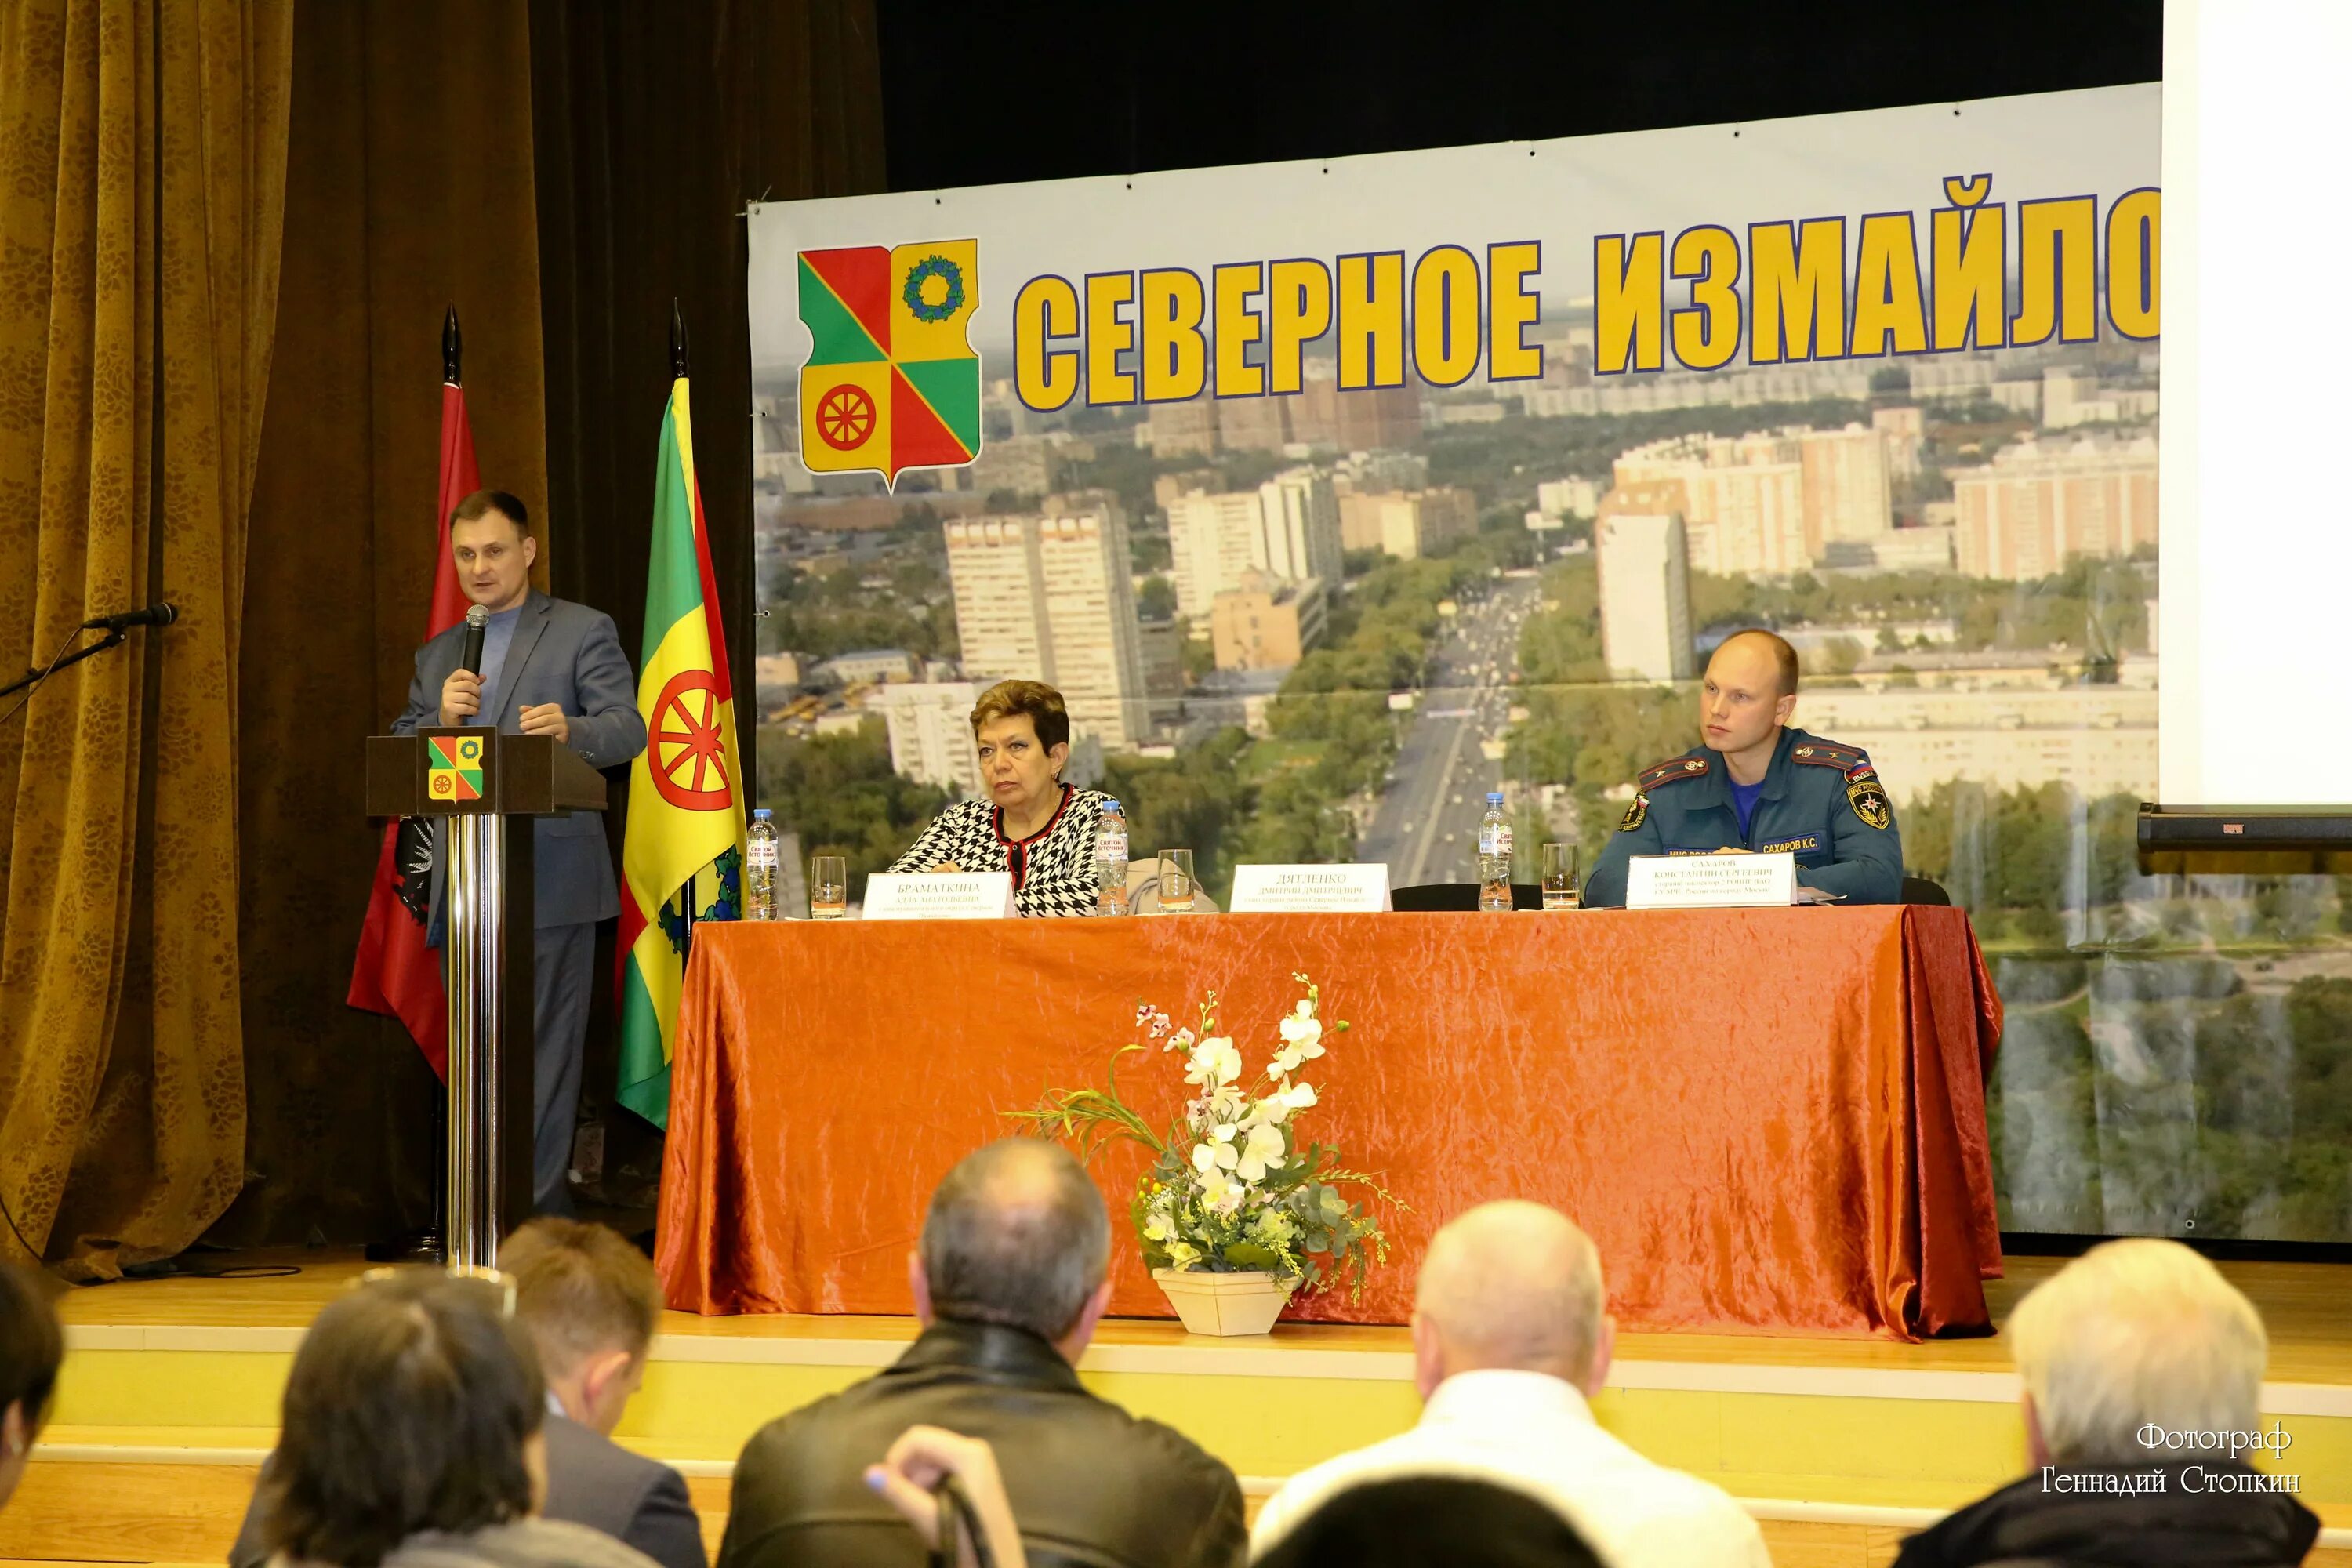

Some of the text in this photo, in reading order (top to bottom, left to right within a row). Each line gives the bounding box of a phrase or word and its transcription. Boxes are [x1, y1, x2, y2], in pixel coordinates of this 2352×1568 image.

[1012, 173, 2161, 413] СЕВЕРНОЕ ИЗМАЙЛО
[1763, 837, 1818, 853] САХАРОВ К.С.
[1276, 873, 1346, 884] ДЯТЛЕНКО
[898, 884, 980, 894] БРАМАТКИНА
